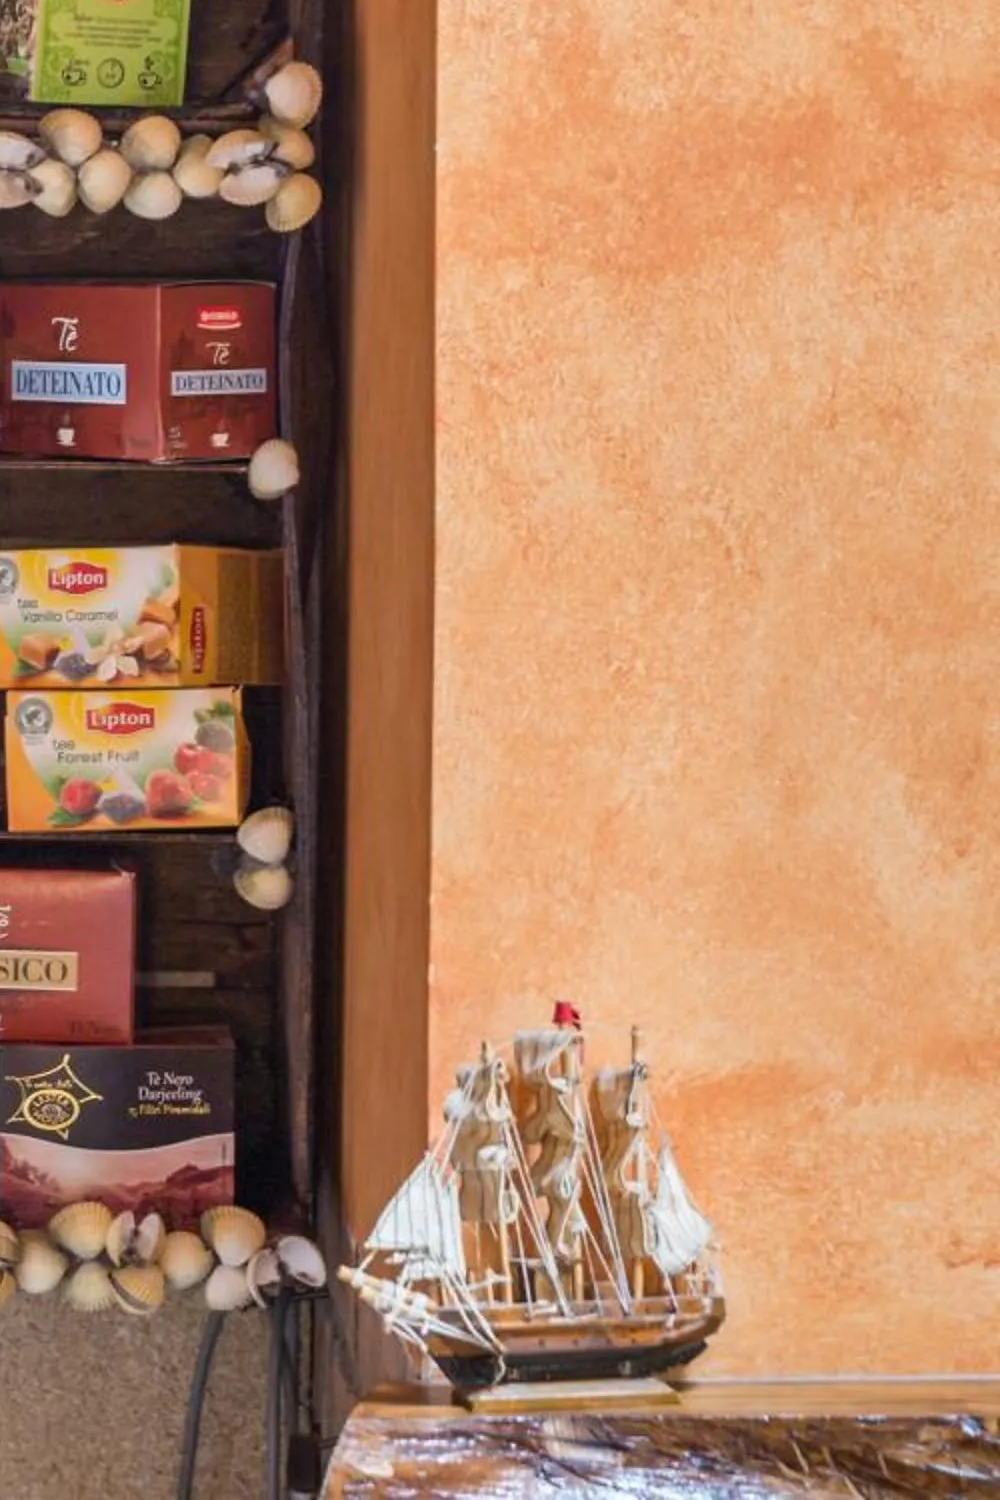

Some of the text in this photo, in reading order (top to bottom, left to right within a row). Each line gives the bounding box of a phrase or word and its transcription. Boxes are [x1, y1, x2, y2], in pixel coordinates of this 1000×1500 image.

[15, 368, 122, 398] DETEINATO
[175, 372, 264, 392] DETEINATO
[51, 570, 105, 589] Lipton
[90, 710, 151, 730] Lipton
[57, 751, 103, 764] Forest
